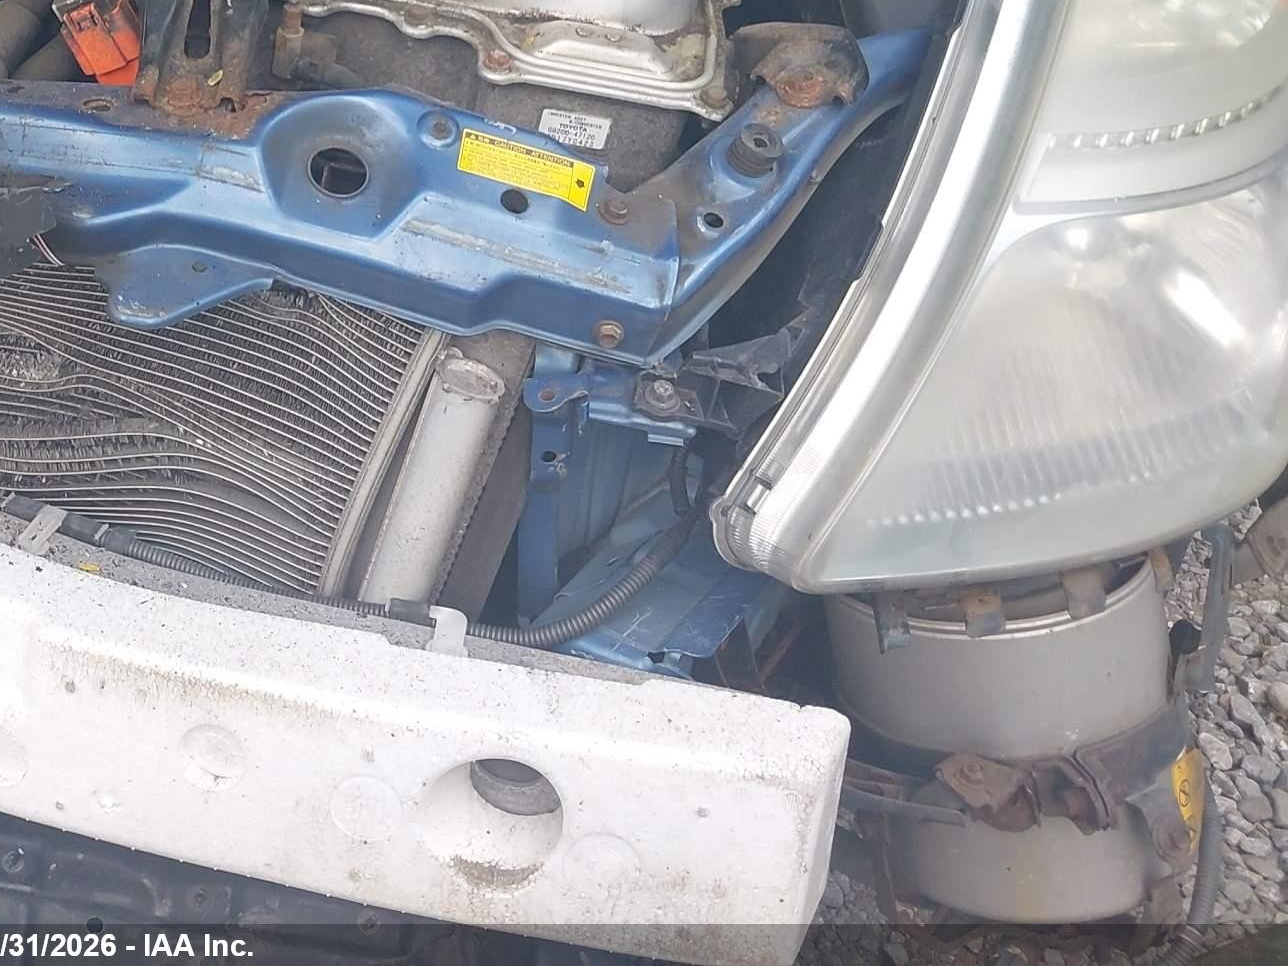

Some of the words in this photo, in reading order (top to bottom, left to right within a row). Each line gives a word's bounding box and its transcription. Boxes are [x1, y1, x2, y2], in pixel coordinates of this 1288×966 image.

[559, 123, 588, 132] TOYOTA
[494, 140, 528, 155] CAUTION
[531, 151, 572, 167] ATTENTION
